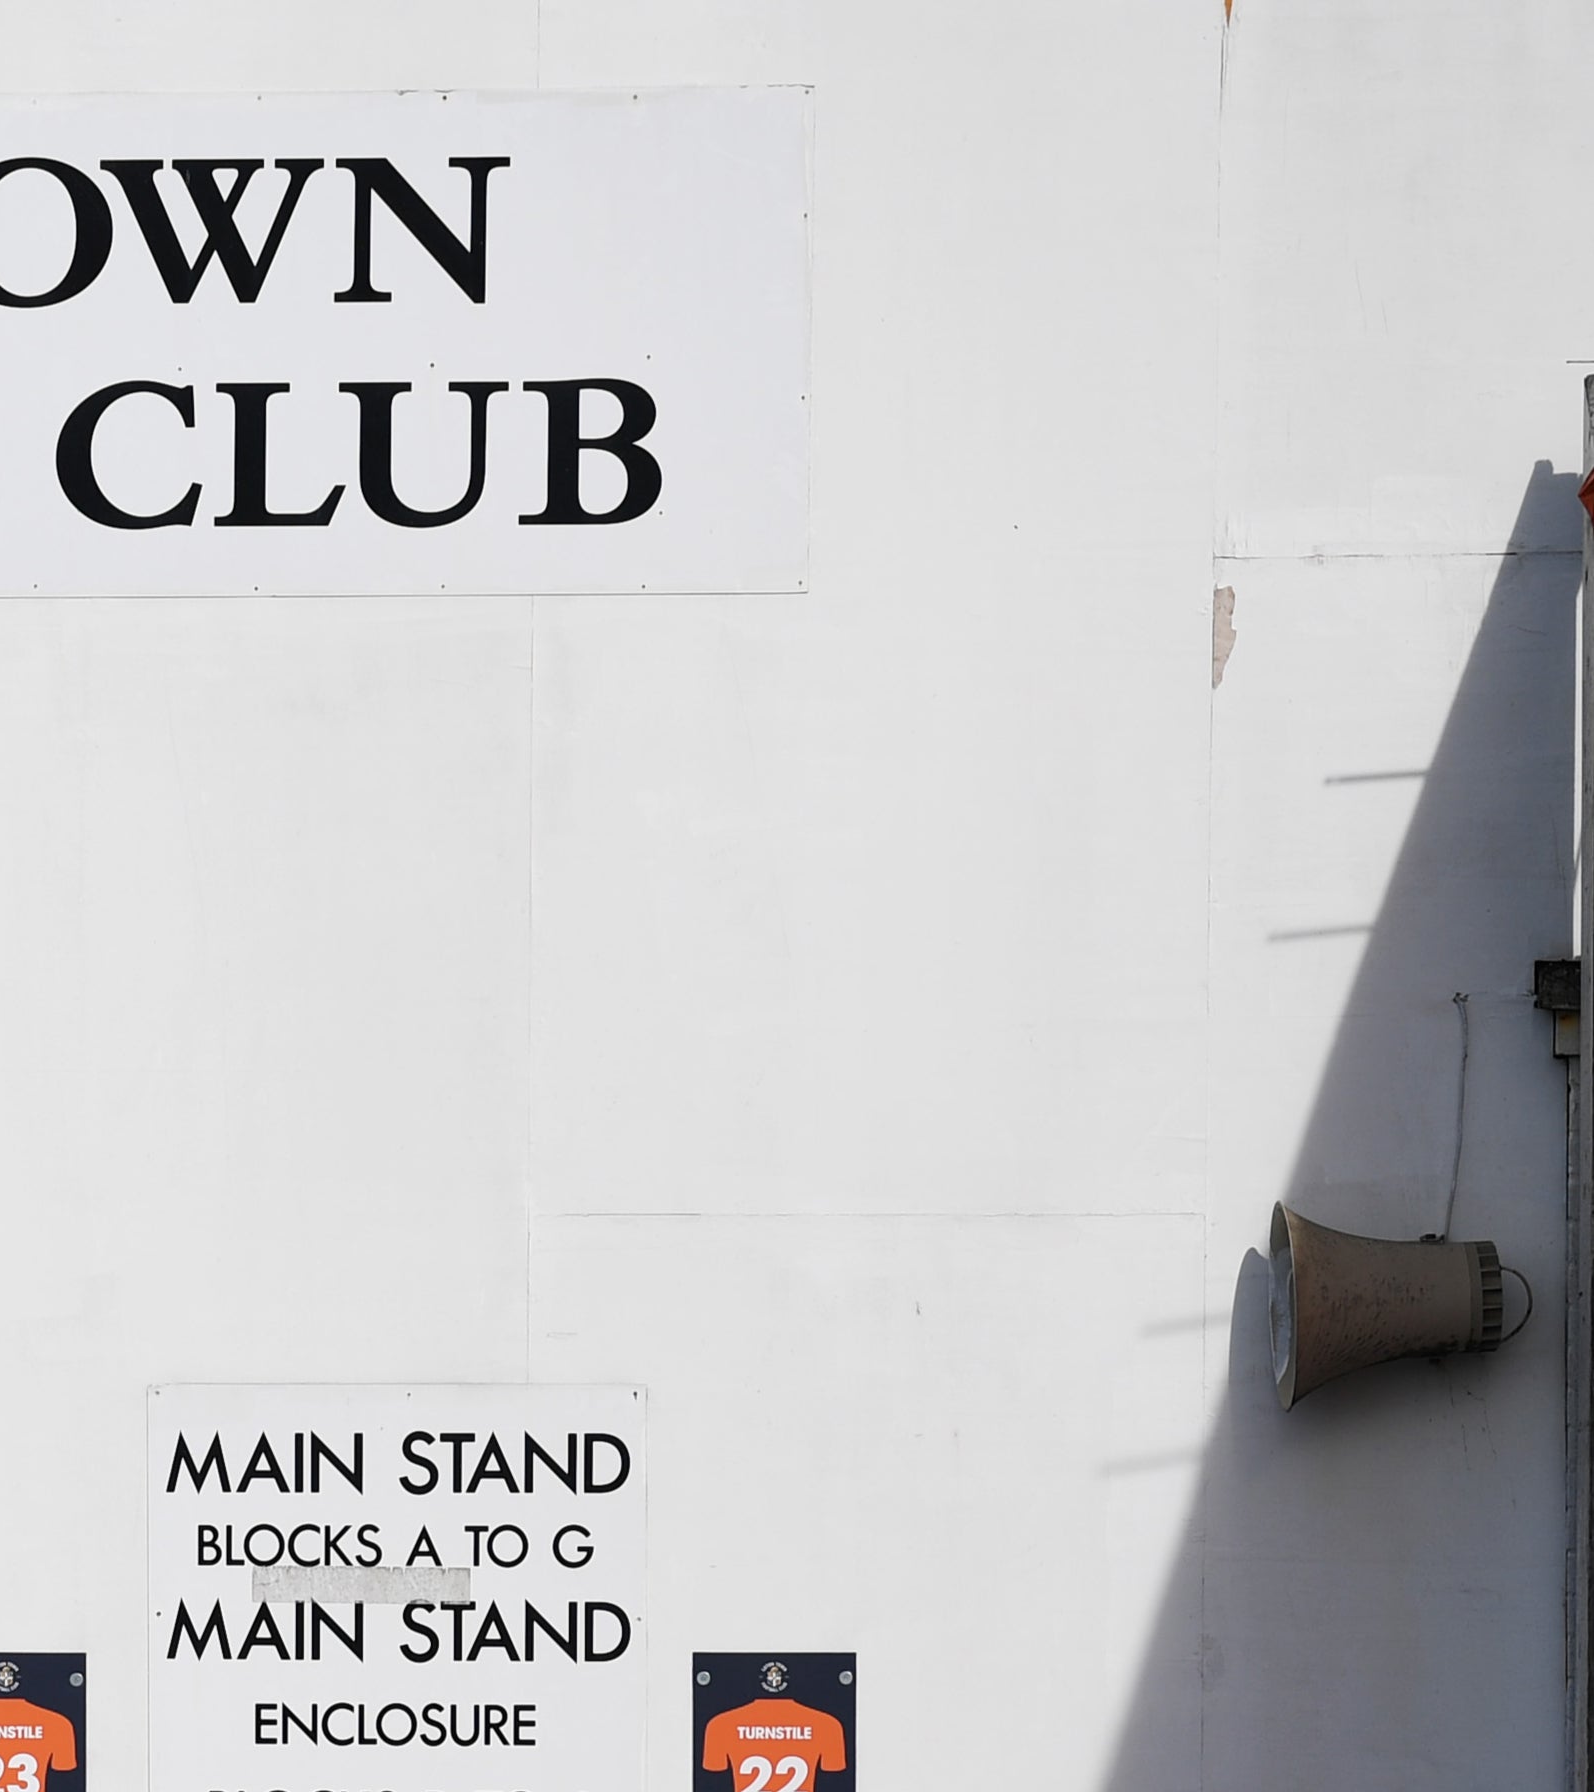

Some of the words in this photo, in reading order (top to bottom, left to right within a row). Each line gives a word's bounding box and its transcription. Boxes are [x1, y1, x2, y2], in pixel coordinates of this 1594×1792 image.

[56, 378, 662, 529] CLUB
[166, 1431, 363, 1494] MAIN
[400, 1431, 630, 1495] STAND
[198, 1524, 382, 1566] BLOCKS
[407, 1526, 441, 1566] A
[465, 1525, 528, 1568] TO
[553, 1525, 594, 1568] G
[166, 1598, 364, 1662] MAIN
[399, 1598, 631, 1664] STAND
[255, 1703, 535, 1746] ENCLOSURE
[737, 1727, 811, 1739] TURNSTILE
